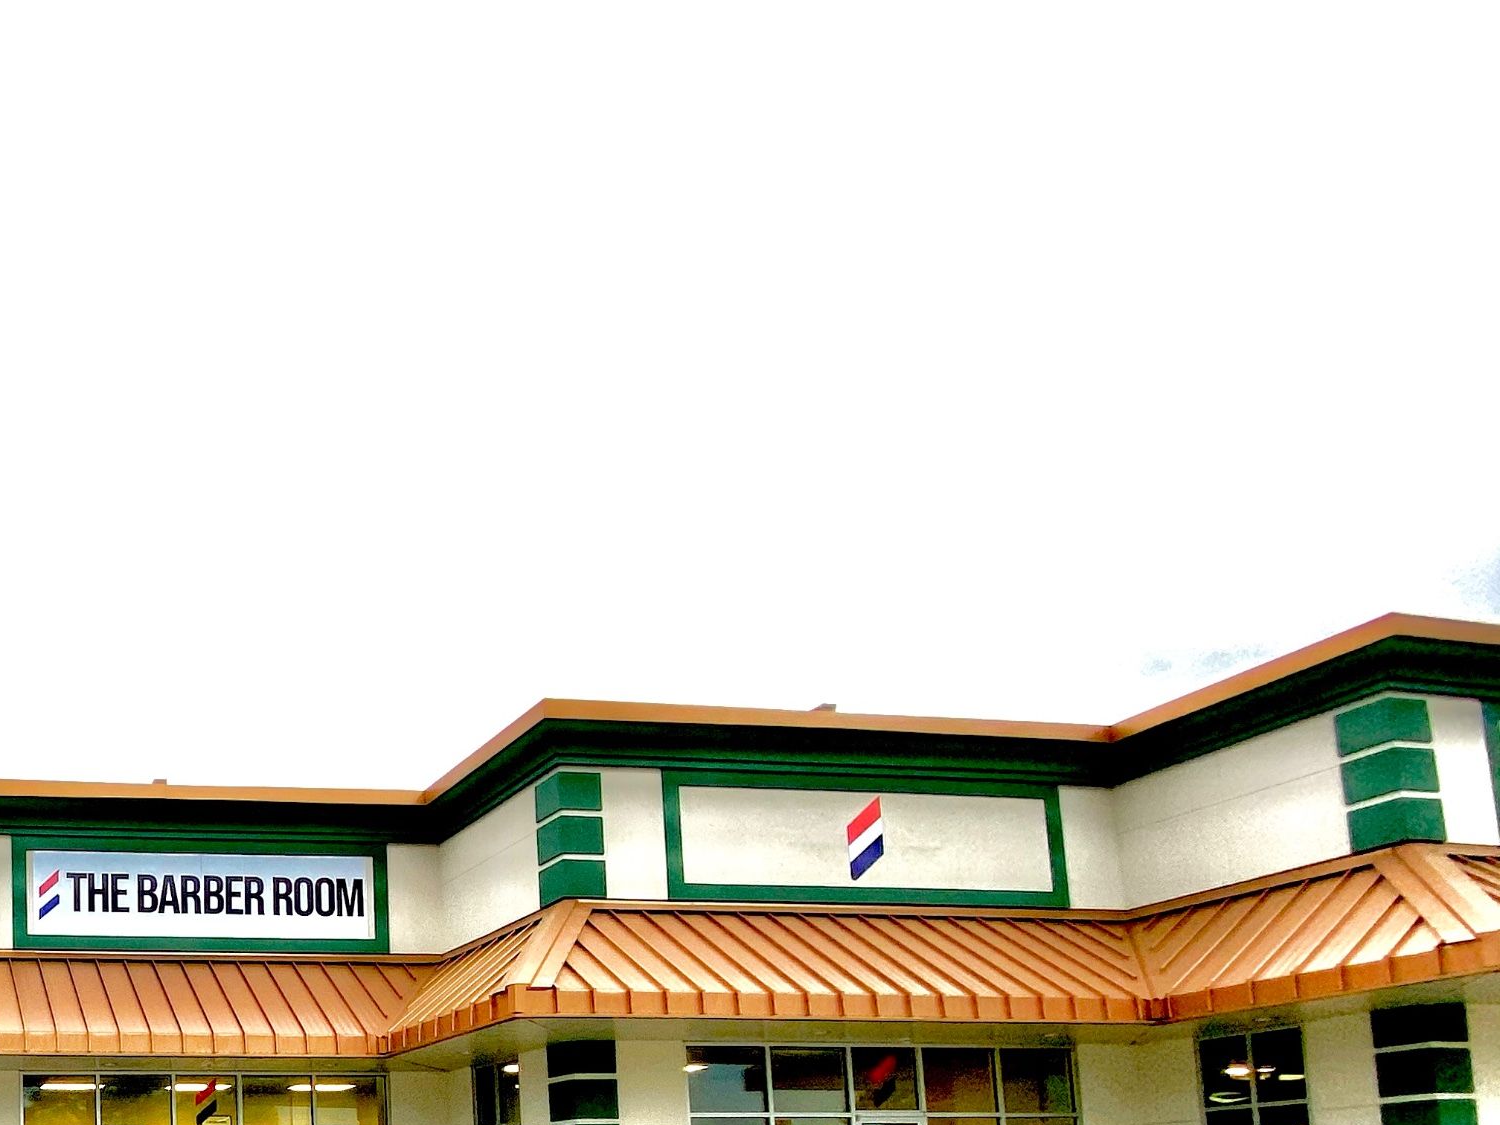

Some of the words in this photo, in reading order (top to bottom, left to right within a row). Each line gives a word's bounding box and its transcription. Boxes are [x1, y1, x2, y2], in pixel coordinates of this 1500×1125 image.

[66, 872, 130, 912] THE
[137, 874, 265, 915] BARBER
[272, 876, 365, 917] ROOM
